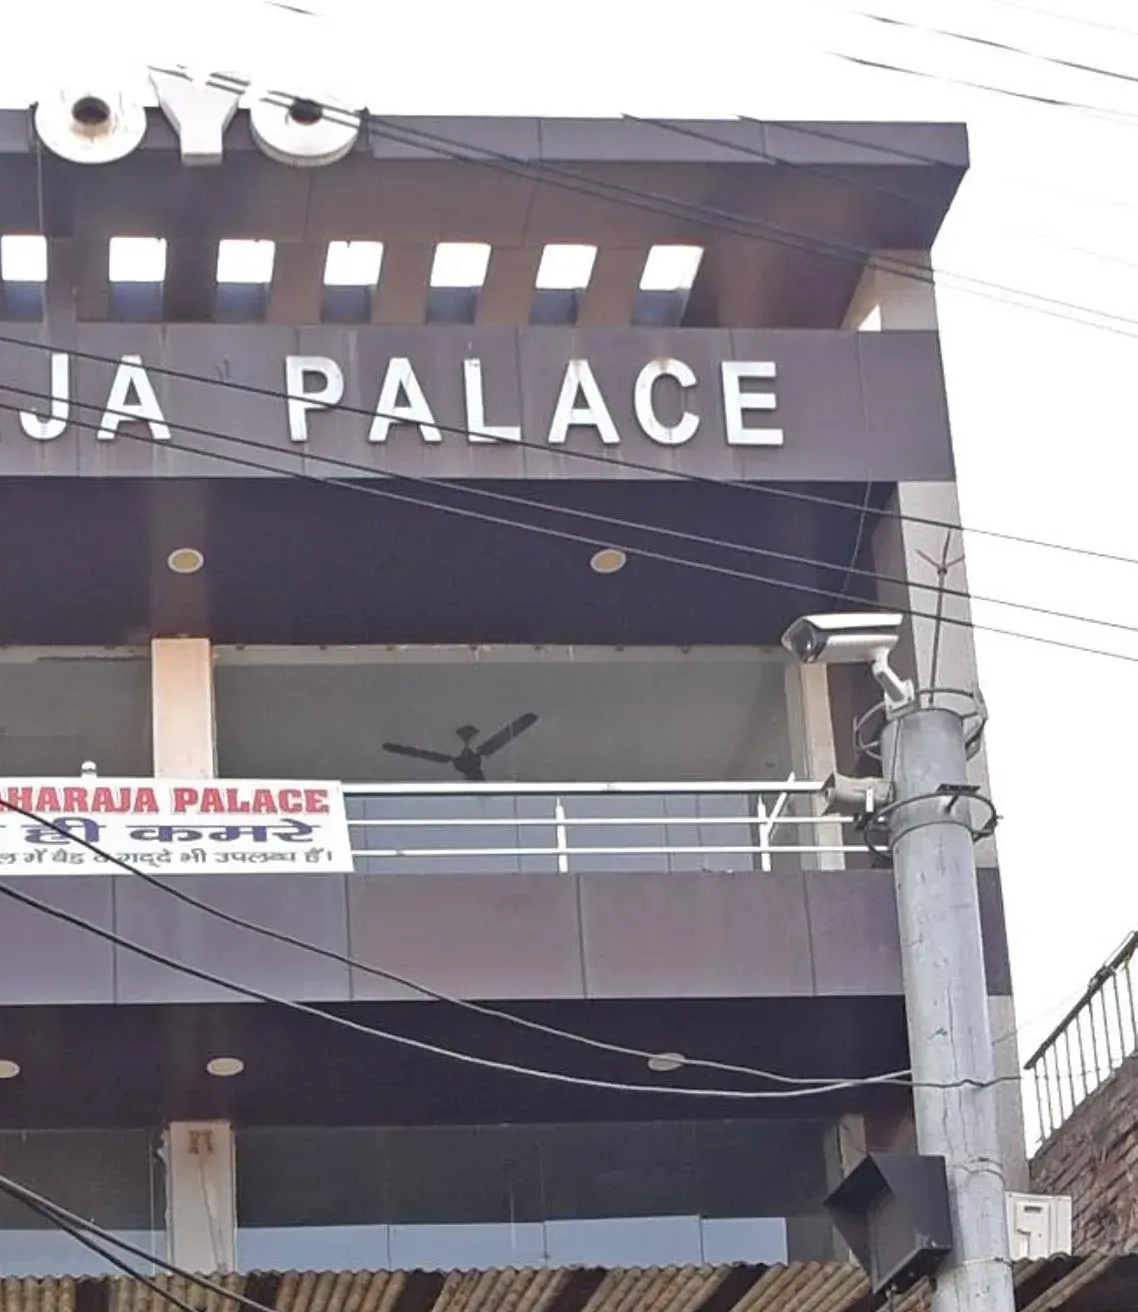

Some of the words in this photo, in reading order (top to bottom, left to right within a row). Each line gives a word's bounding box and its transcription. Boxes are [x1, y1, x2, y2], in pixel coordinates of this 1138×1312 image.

[287, 354, 784, 447] PALACE
[173, 788, 330, 813] PALACE
[20, 816, 107, 844] ही
[125, 818, 321, 842] कमरे
